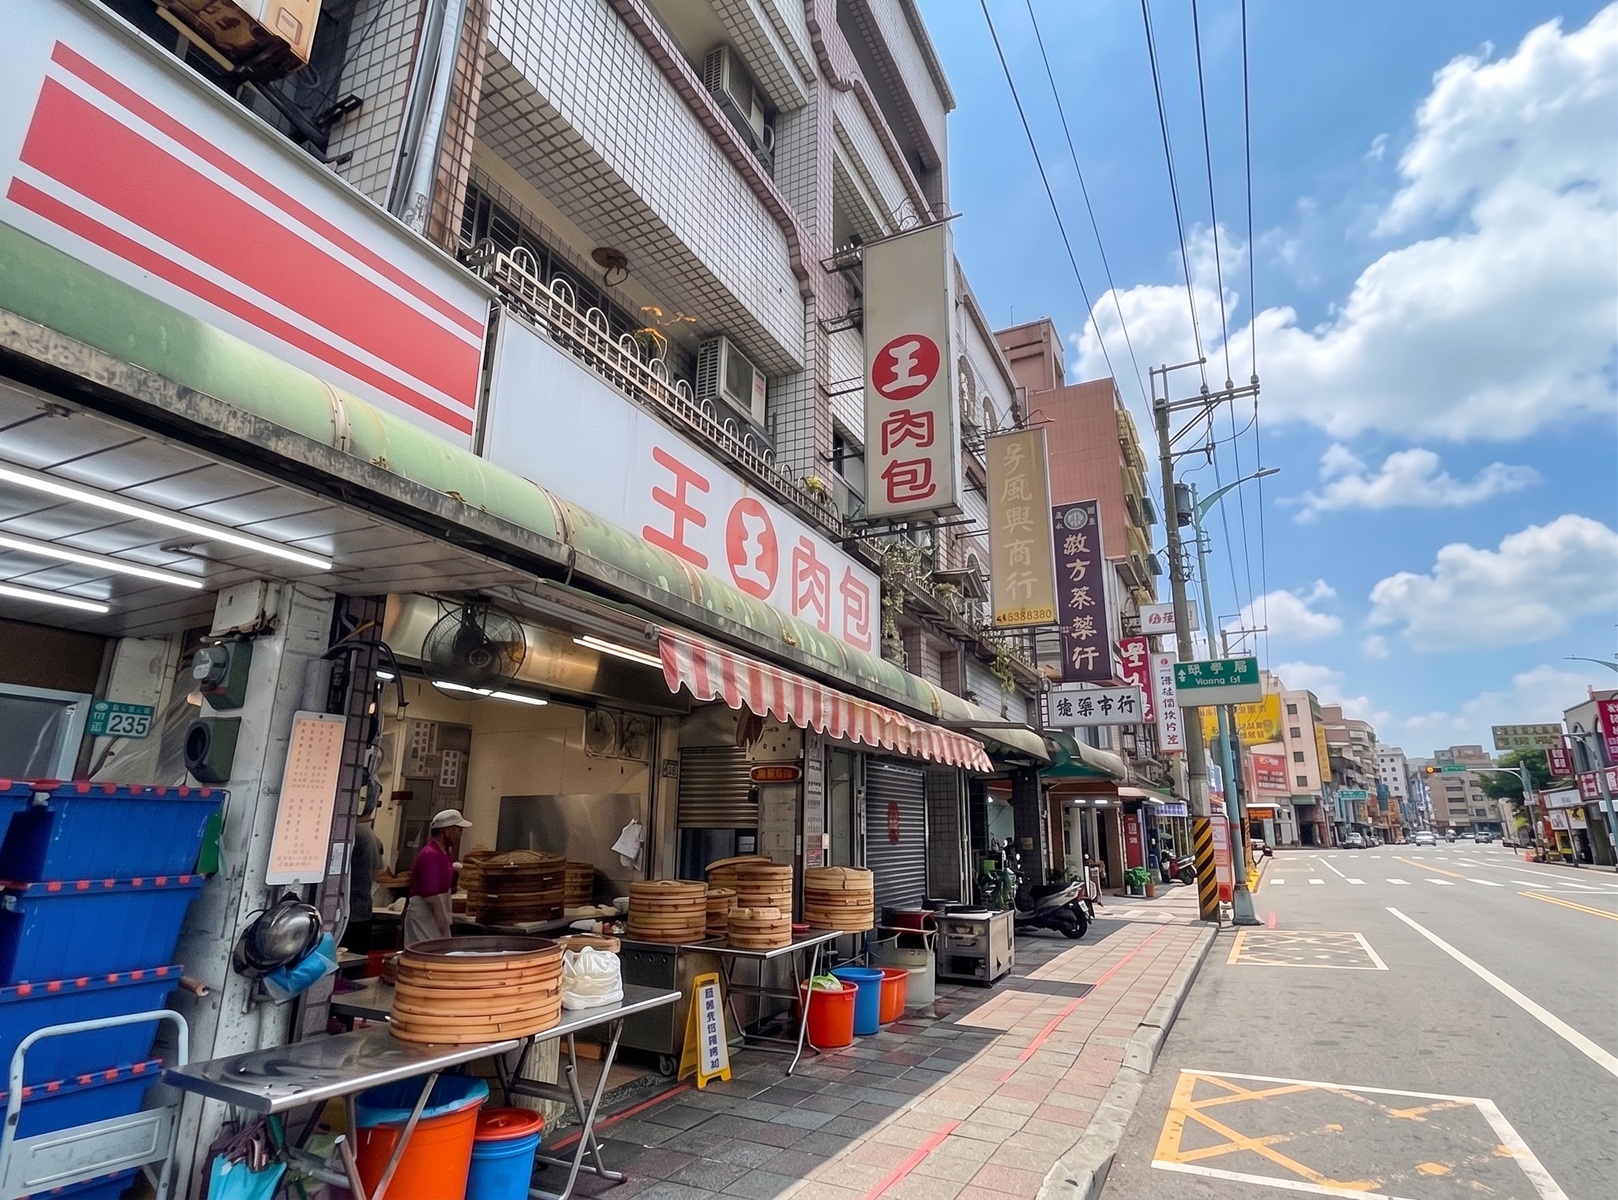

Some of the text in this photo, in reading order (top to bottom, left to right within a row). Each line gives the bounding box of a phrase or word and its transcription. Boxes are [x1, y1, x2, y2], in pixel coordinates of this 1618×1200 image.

[872, 334, 940, 504] 王肉包
[109, 714, 149, 735] 235
